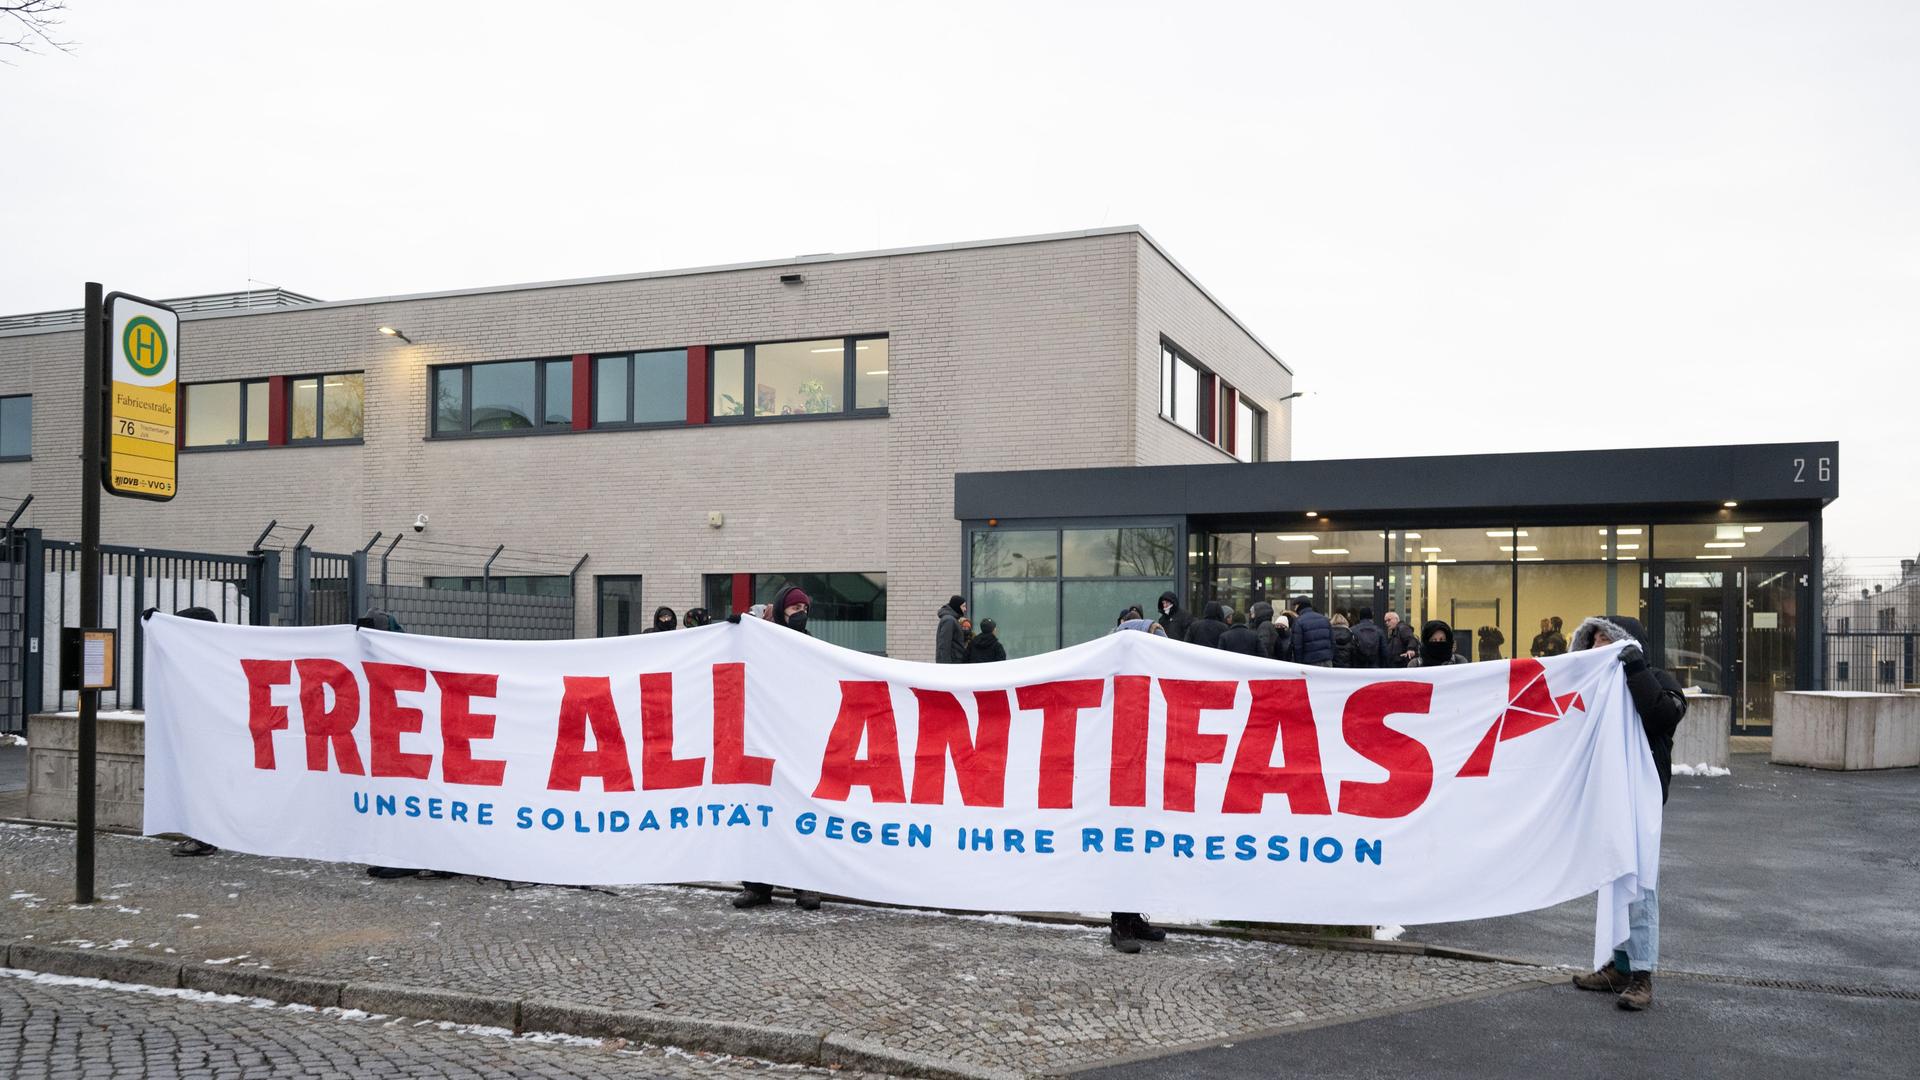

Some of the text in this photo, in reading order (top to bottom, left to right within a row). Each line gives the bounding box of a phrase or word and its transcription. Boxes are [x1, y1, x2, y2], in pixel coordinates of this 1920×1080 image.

[137, 328, 155, 364] H
[117, 394, 172, 415] Fabricestraße
[119, 420, 135, 436] 76
[148, 480, 166, 490] VVO
[241, 659, 1434, 819] FREE ALL ANTIFAS
[353, 791, 1383, 866] UNSERE SOLIDARITÄT GEGEN IHRE REPRESSION
